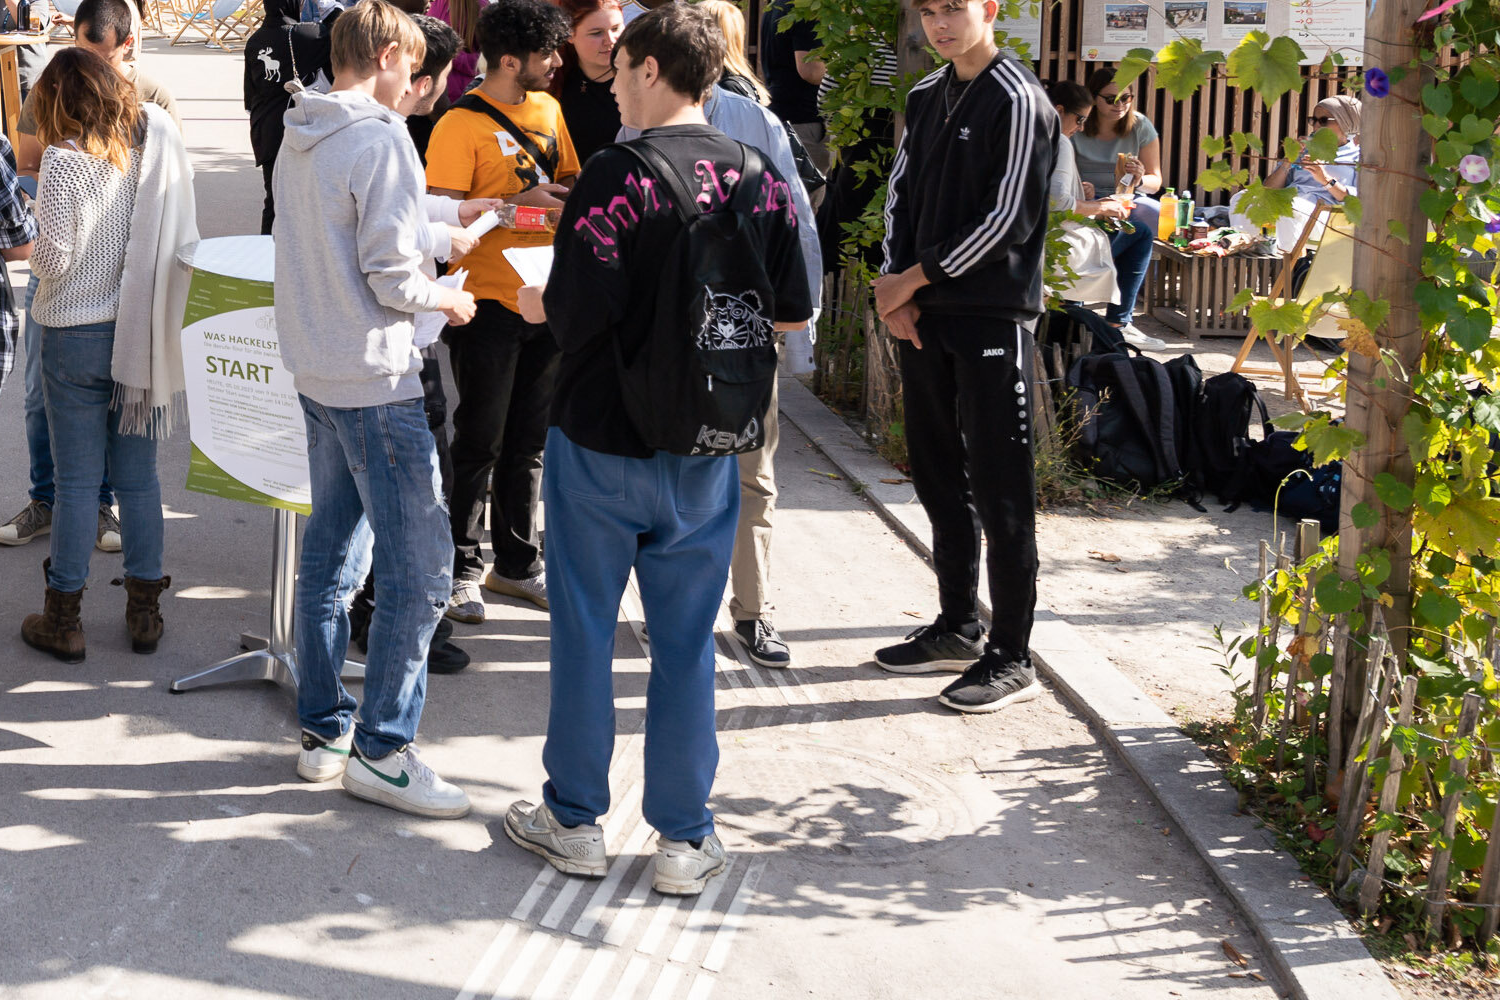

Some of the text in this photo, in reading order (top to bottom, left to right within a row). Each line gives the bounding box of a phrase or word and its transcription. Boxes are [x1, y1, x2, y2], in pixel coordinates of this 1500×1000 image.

[203, 331, 278, 350] WAS HACKELST
[982, 348, 1005, 357] JAKO
[206, 355, 274, 384] START
